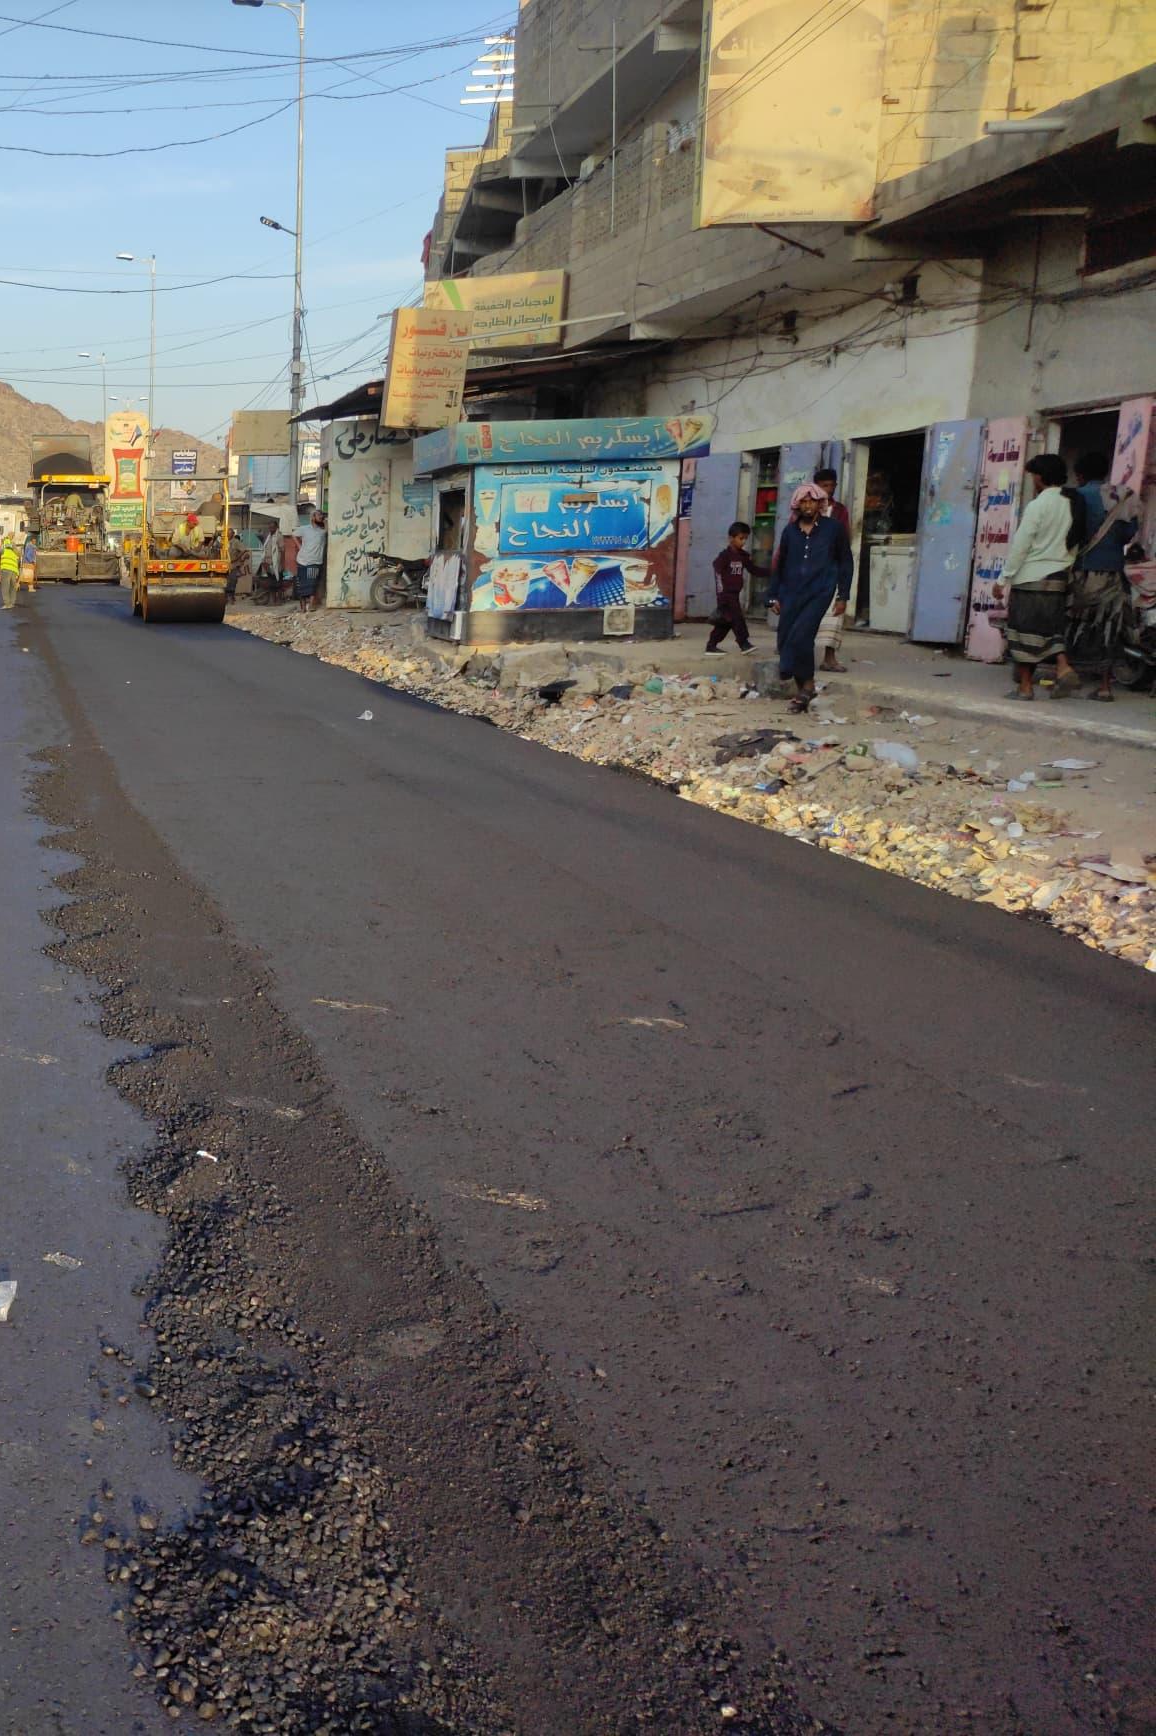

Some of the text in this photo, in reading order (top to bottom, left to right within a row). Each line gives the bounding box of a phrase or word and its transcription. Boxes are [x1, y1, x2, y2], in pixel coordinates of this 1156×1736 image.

[499, 430, 571, 453] النجاح
[493, 464, 554, 477] المناسبات
[599, 463, 663, 476] مستعدون
[507, 520, 590, 547] النجاح
